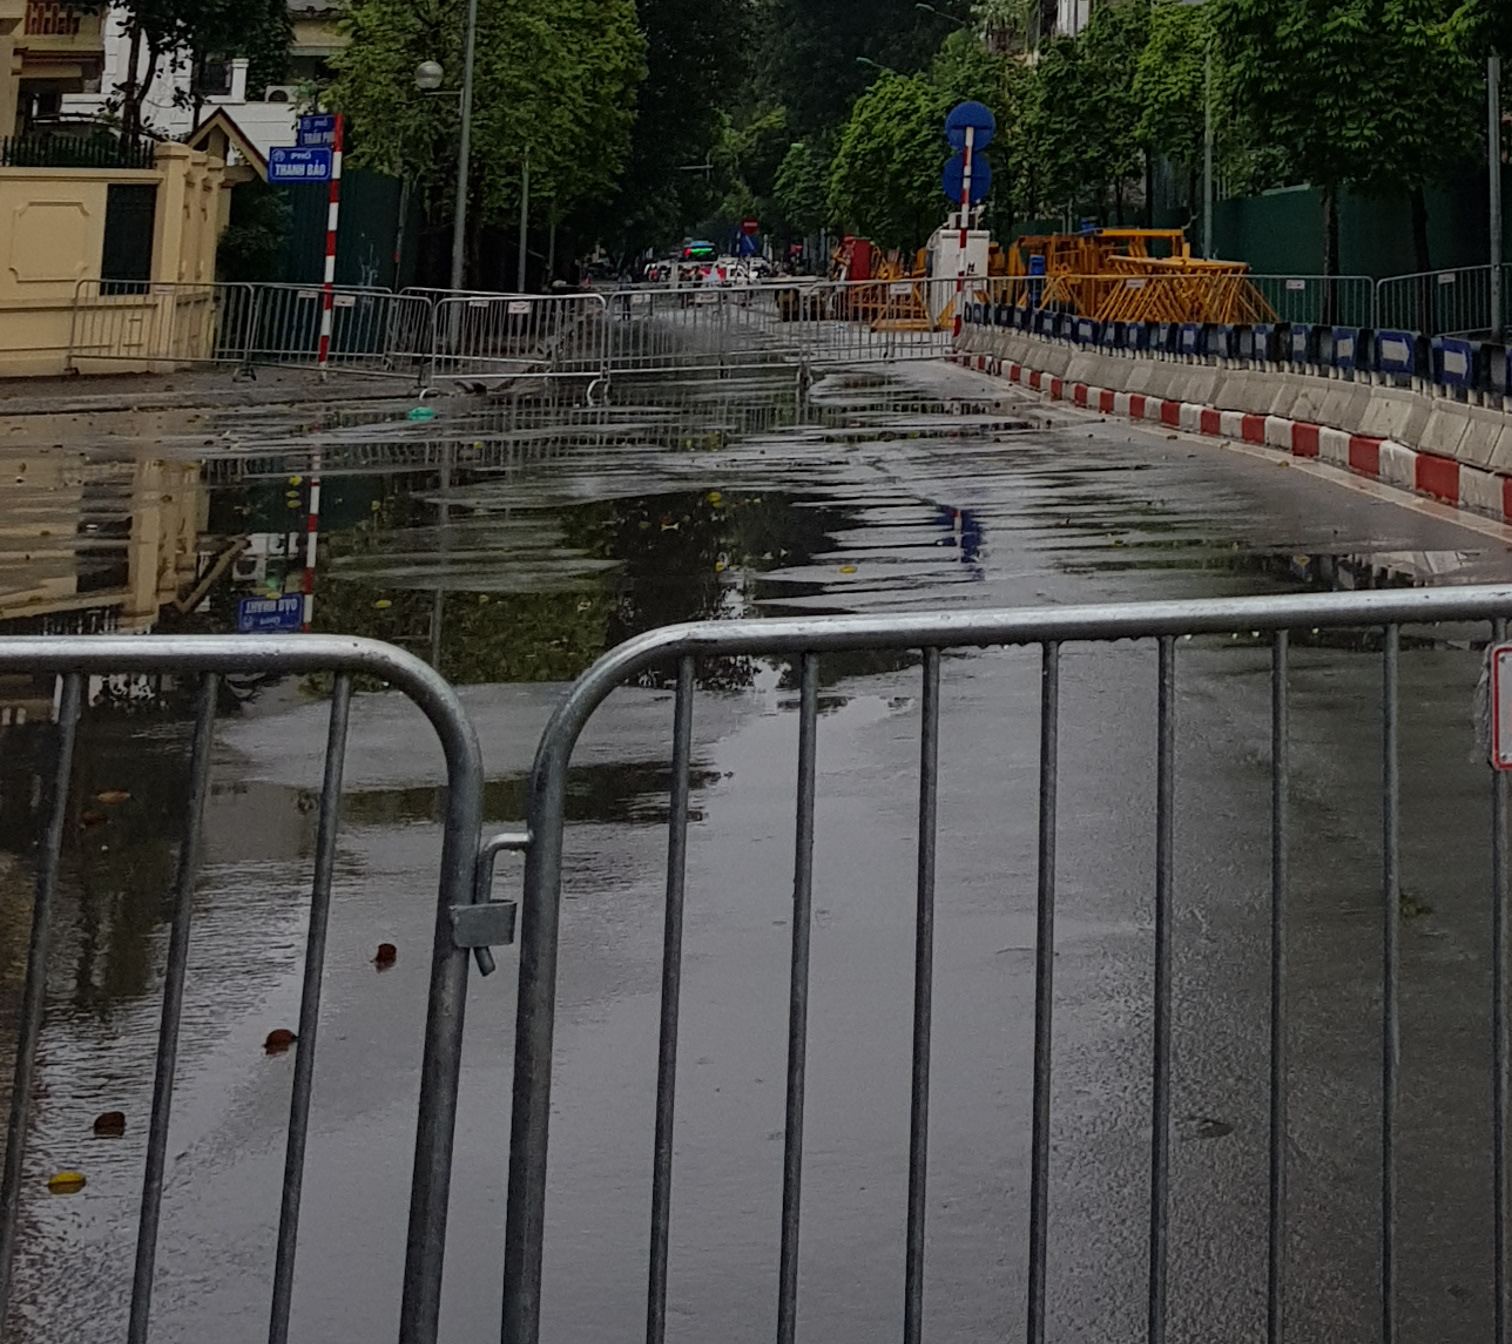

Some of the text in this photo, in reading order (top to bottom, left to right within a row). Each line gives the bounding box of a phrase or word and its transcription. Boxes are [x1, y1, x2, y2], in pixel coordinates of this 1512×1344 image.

[290, 150, 312, 160] PHỐ
[275, 160, 326, 176] THANH BẢO
